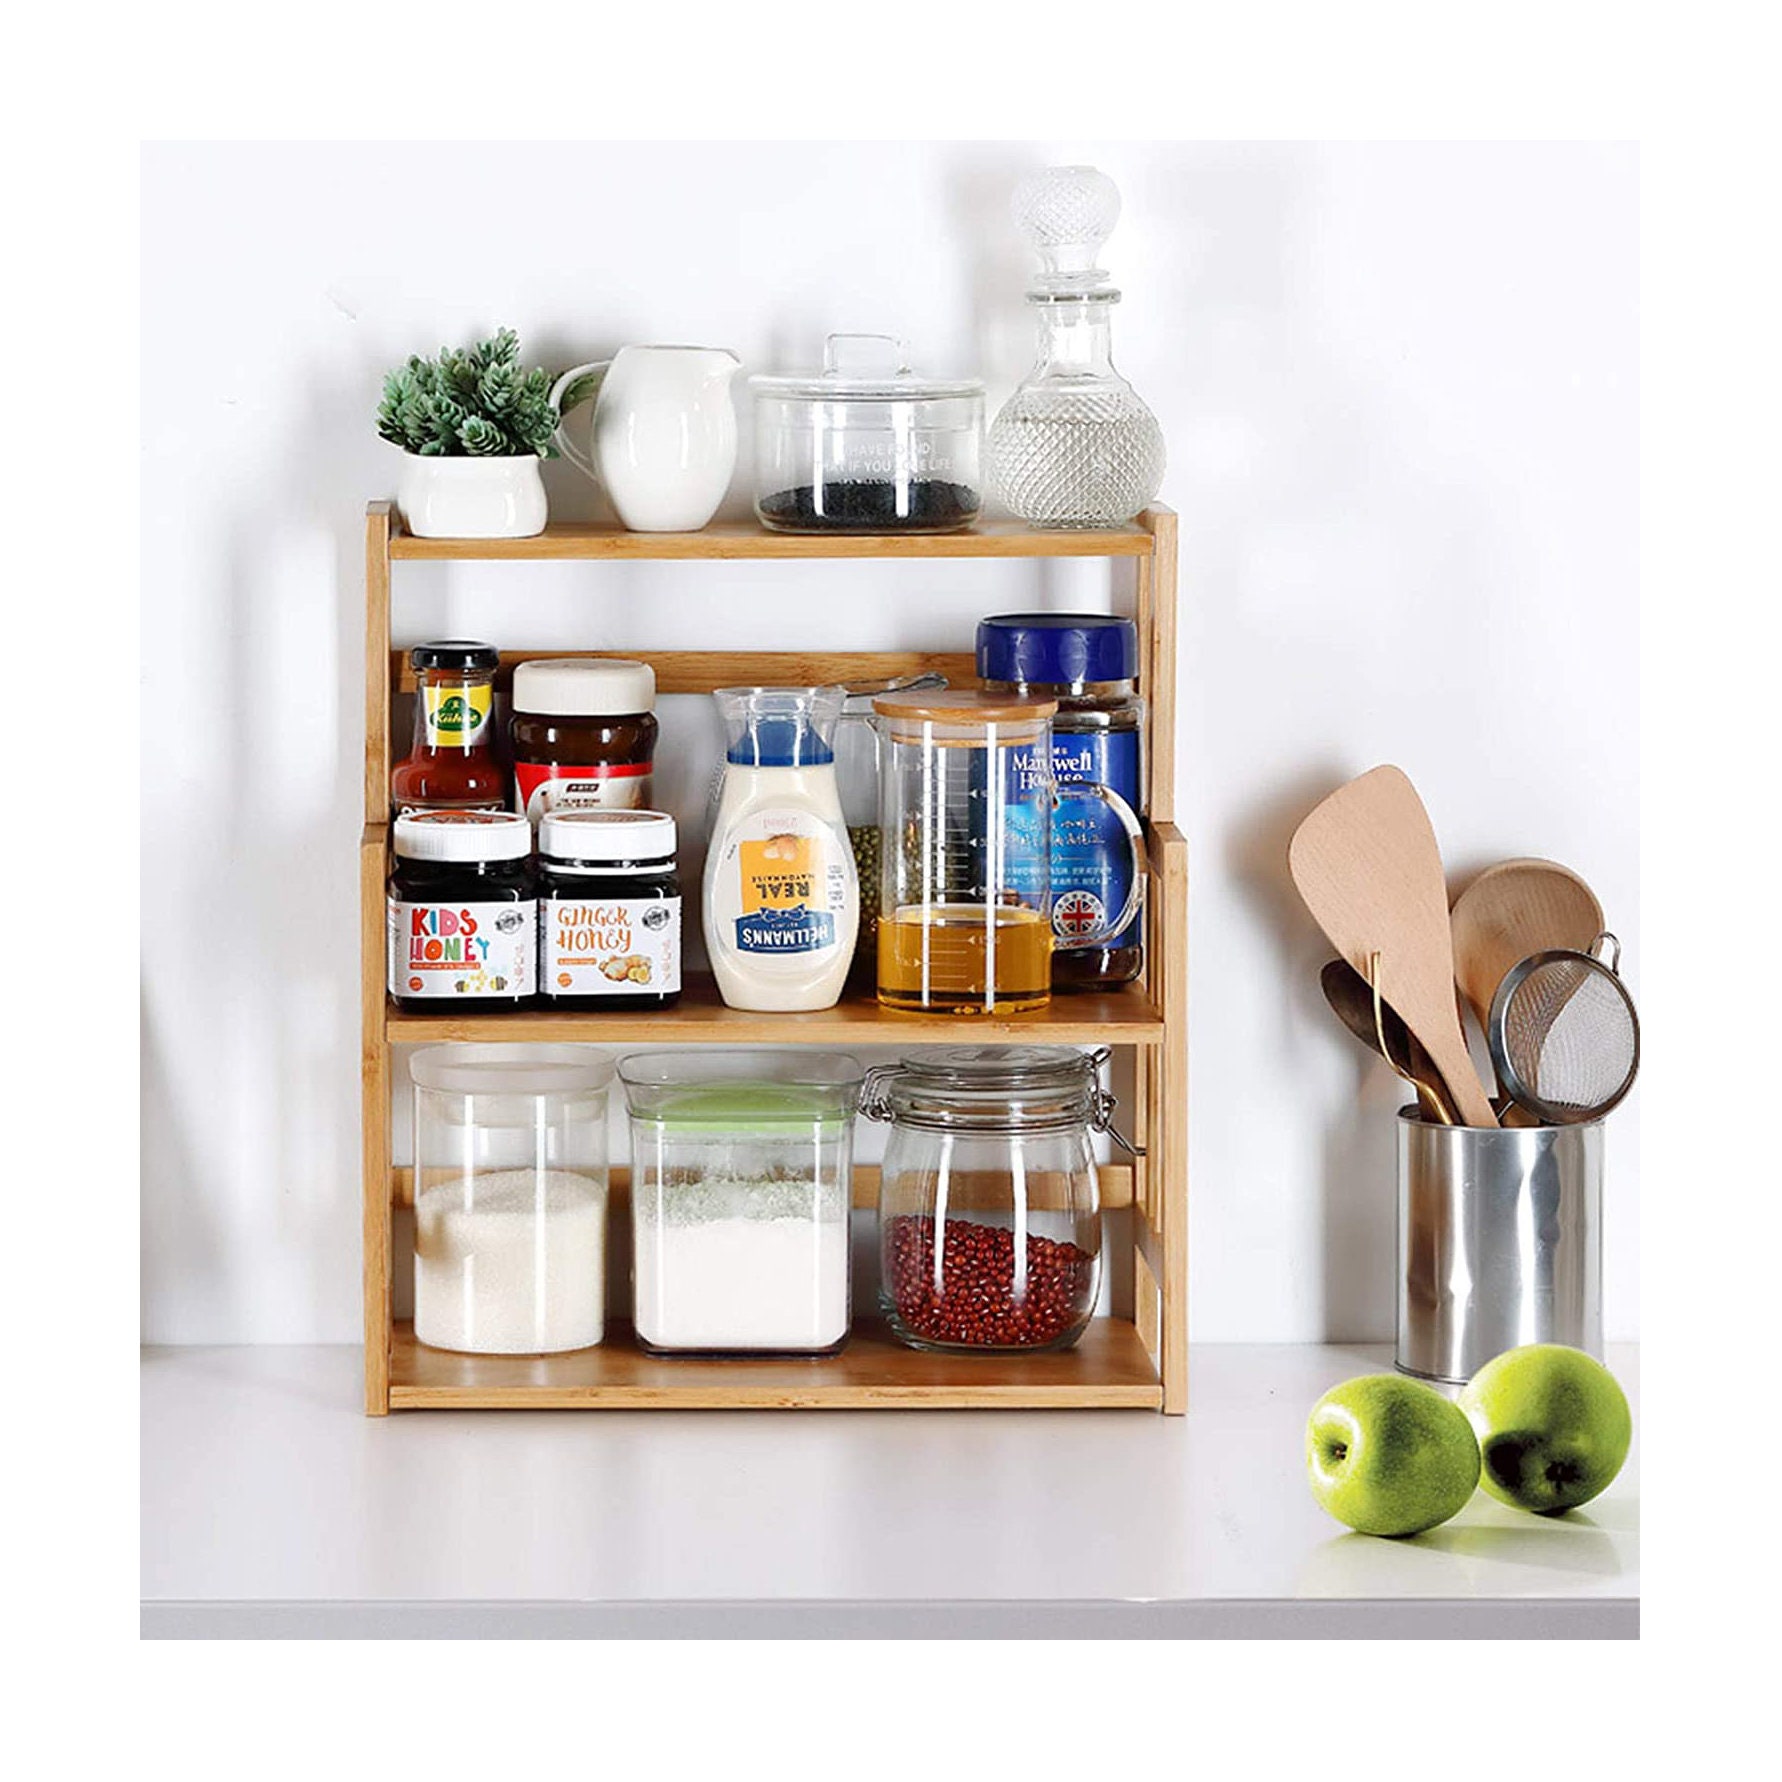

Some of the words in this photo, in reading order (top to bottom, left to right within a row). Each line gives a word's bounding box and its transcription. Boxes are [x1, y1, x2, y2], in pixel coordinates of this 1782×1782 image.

[863, 460, 892, 473] YOU
[752, 874, 815, 883] MAYONNAISE
[756, 881, 810, 899] REAL
[411, 908, 478, 937] KIDS
[557, 905, 632, 927] GINGER
[556, 928, 631, 953] HONEY
[743, 925, 828, 947] HELLMANN'S
[409, 936, 491, 962] HONEY
